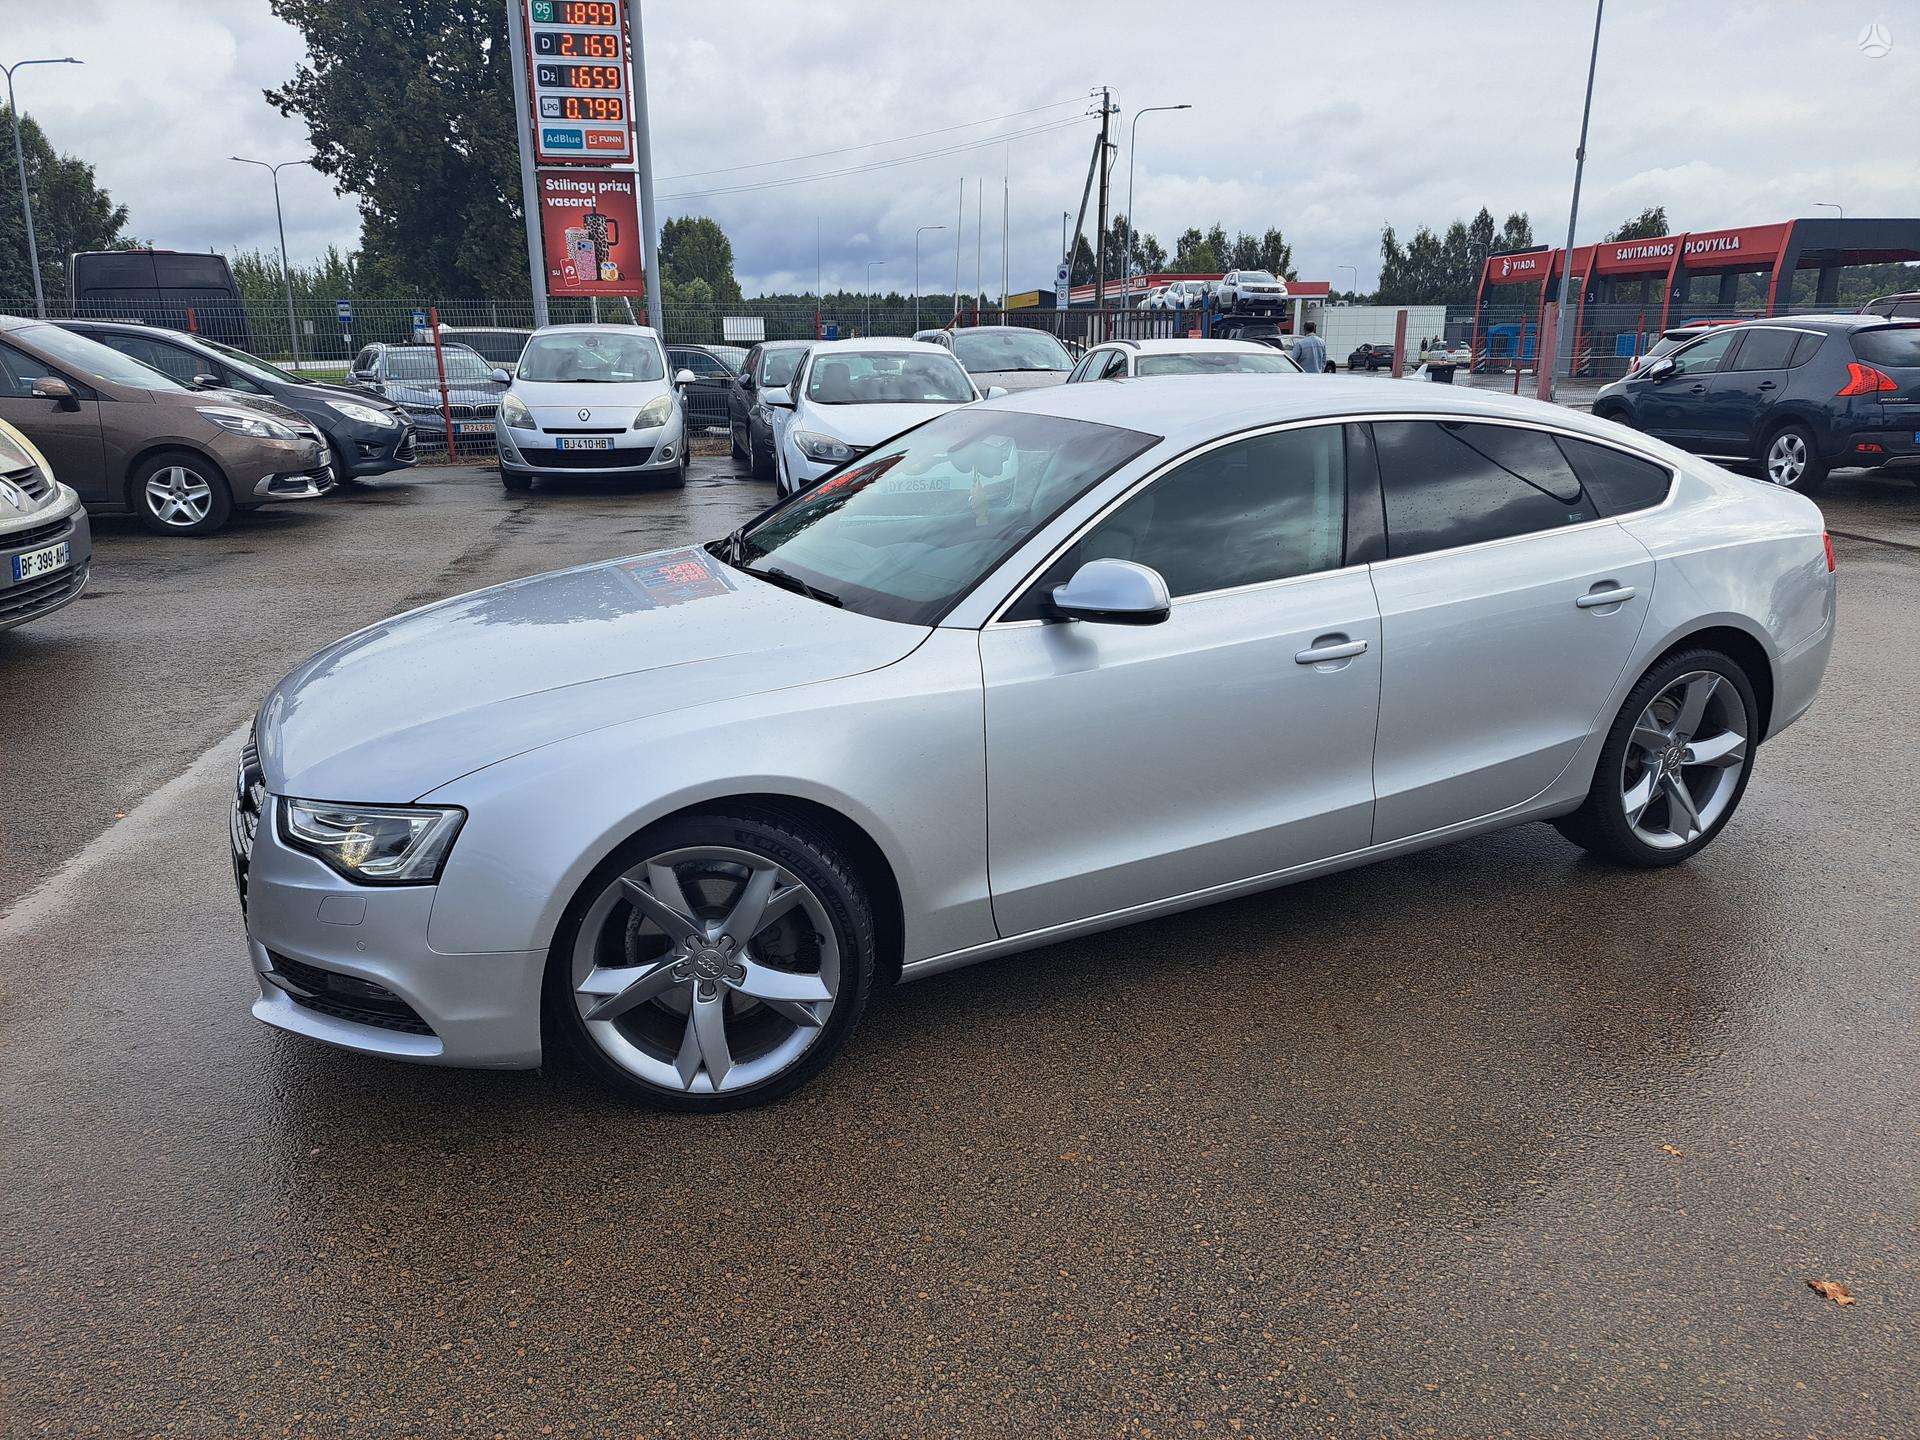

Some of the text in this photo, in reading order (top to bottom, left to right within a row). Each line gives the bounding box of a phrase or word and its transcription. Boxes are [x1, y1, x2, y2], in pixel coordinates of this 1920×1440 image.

[535, 2, 614, 25] 95 1.899
[541, 34, 616, 57] D 2.169
[571, 66, 618, 89] 1.659
[543, 98, 620, 119] LPG 0.799
[546, 134, 581, 144] AdBlue
[545, 178, 632, 195] Stilingų prizų
[546, 195, 597, 207] vasara!
[1616, 235, 1740, 260] SAVITARNOS PLOVYKLA
[1512, 259, 1536, 271] VIADA
[1588, 292, 1594, 302] 3
[1673, 288, 1680, 298] 4
[1482, 300, 1489, 309] 2
[21, 545, 65, 577] BF-399-AH
